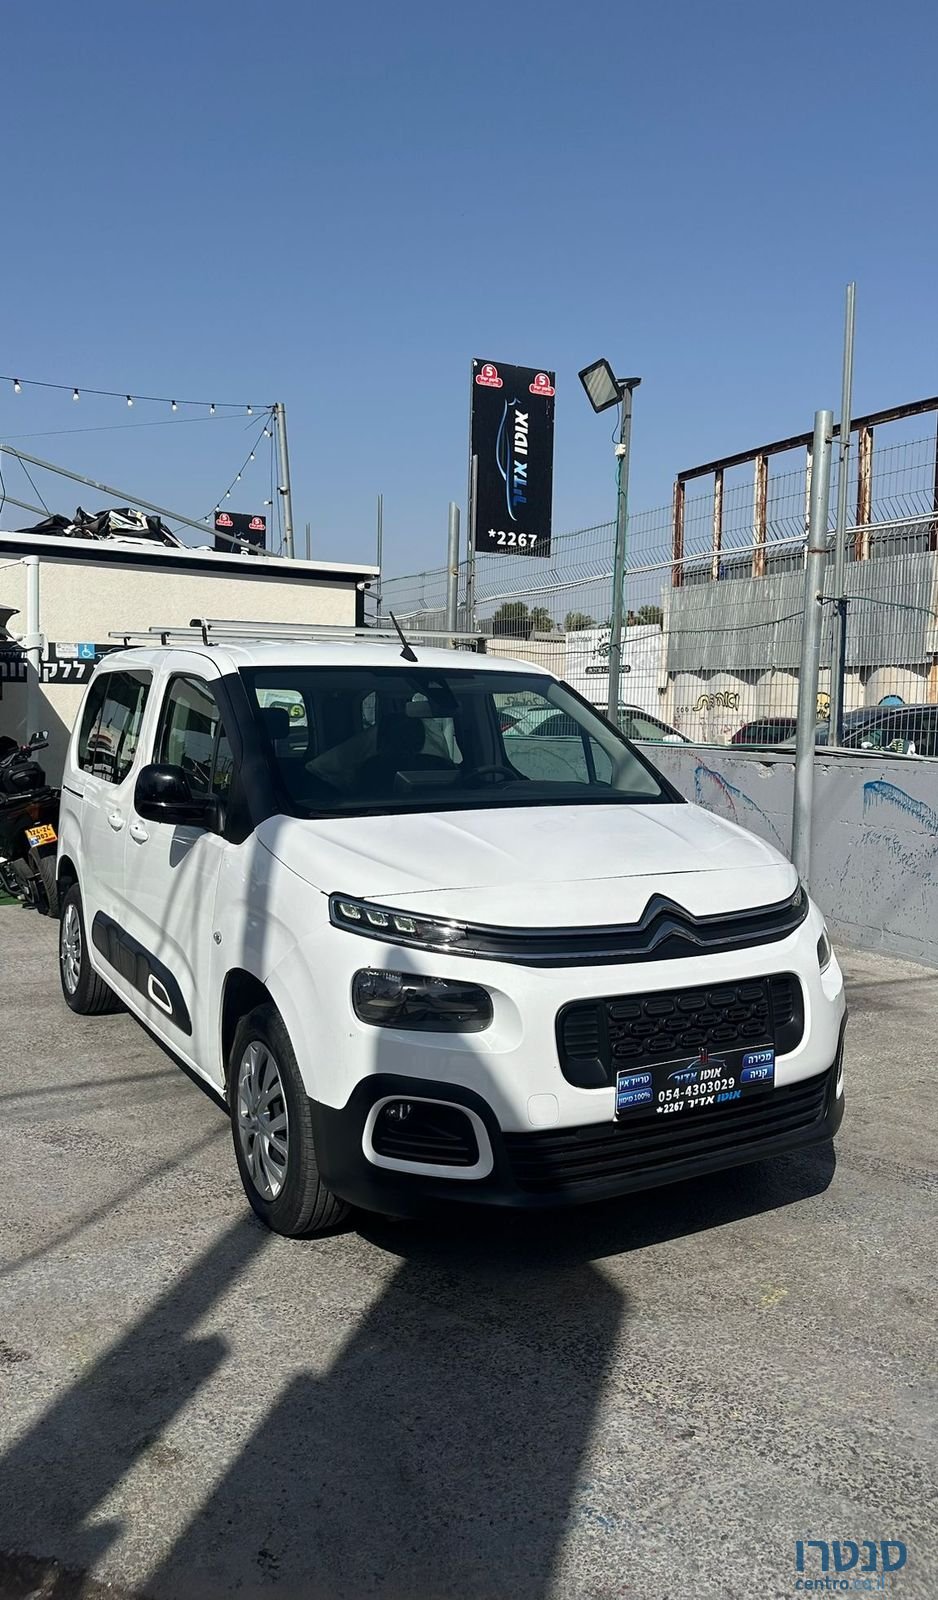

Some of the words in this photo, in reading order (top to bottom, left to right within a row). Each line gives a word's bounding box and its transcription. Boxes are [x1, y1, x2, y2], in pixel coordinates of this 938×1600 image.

[486, 366, 493, 377] 5
[539, 376, 546, 385] 5
[514, 409, 529, 456] אוטו
[748, 1052, 772, 1064] מכירה
[674, 1072, 697, 1084] אדיר
[700, 1067, 722, 1080] אוטו
[750, 1068, 768, 1079] קניה
[619, 1079, 629, 1090] אין
[631, 1075, 650, 1086] טרייד
[658, 1077, 735, 1102] 054-4303029
[687, 1095, 715, 1109] אדיר
[717, 1089, 742, 1103] אוטו
